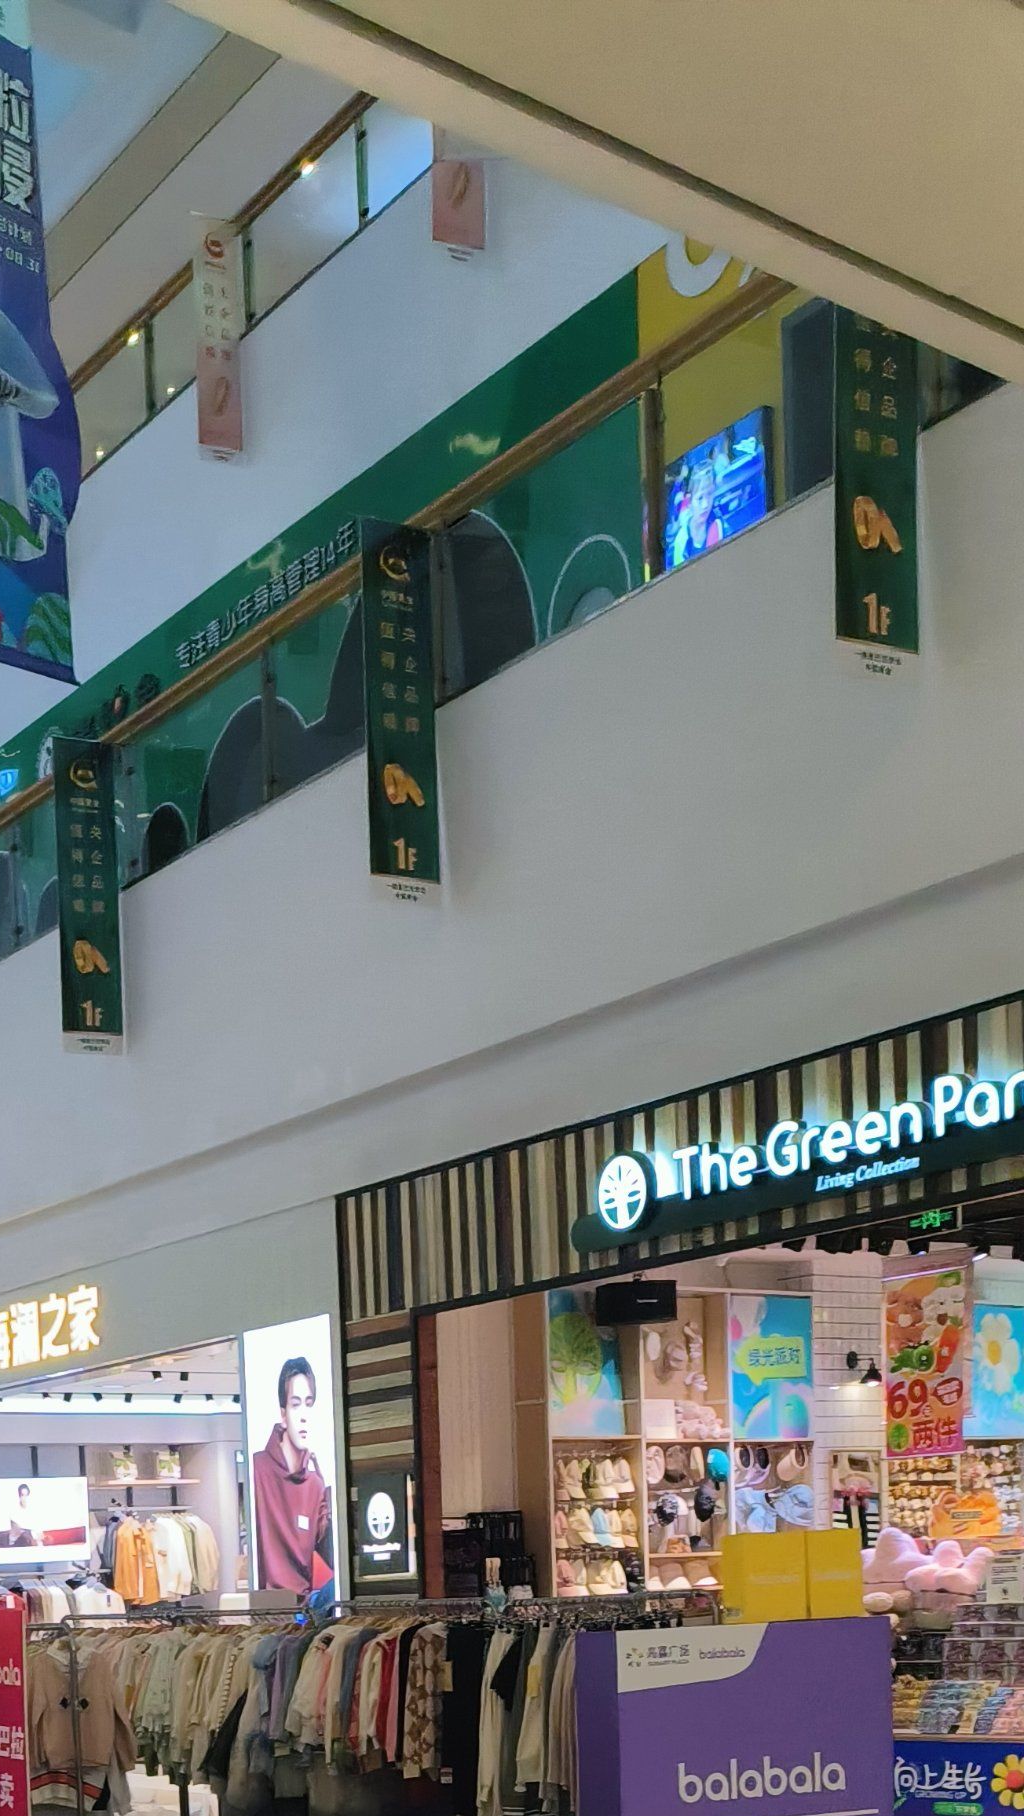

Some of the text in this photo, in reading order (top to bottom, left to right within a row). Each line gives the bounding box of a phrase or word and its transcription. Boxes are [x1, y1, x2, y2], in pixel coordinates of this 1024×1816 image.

[392, 837, 417, 872] 1F
[80, 1000, 105, 1027] 1F
[673, 1142, 758, 1200] The
[766, 1102, 924, 1178] Green
[815, 1156, 921, 1193] Living Collection
[677, 1751, 847, 1803] balabala
[893, 1755, 988, 1800] 向上生长
